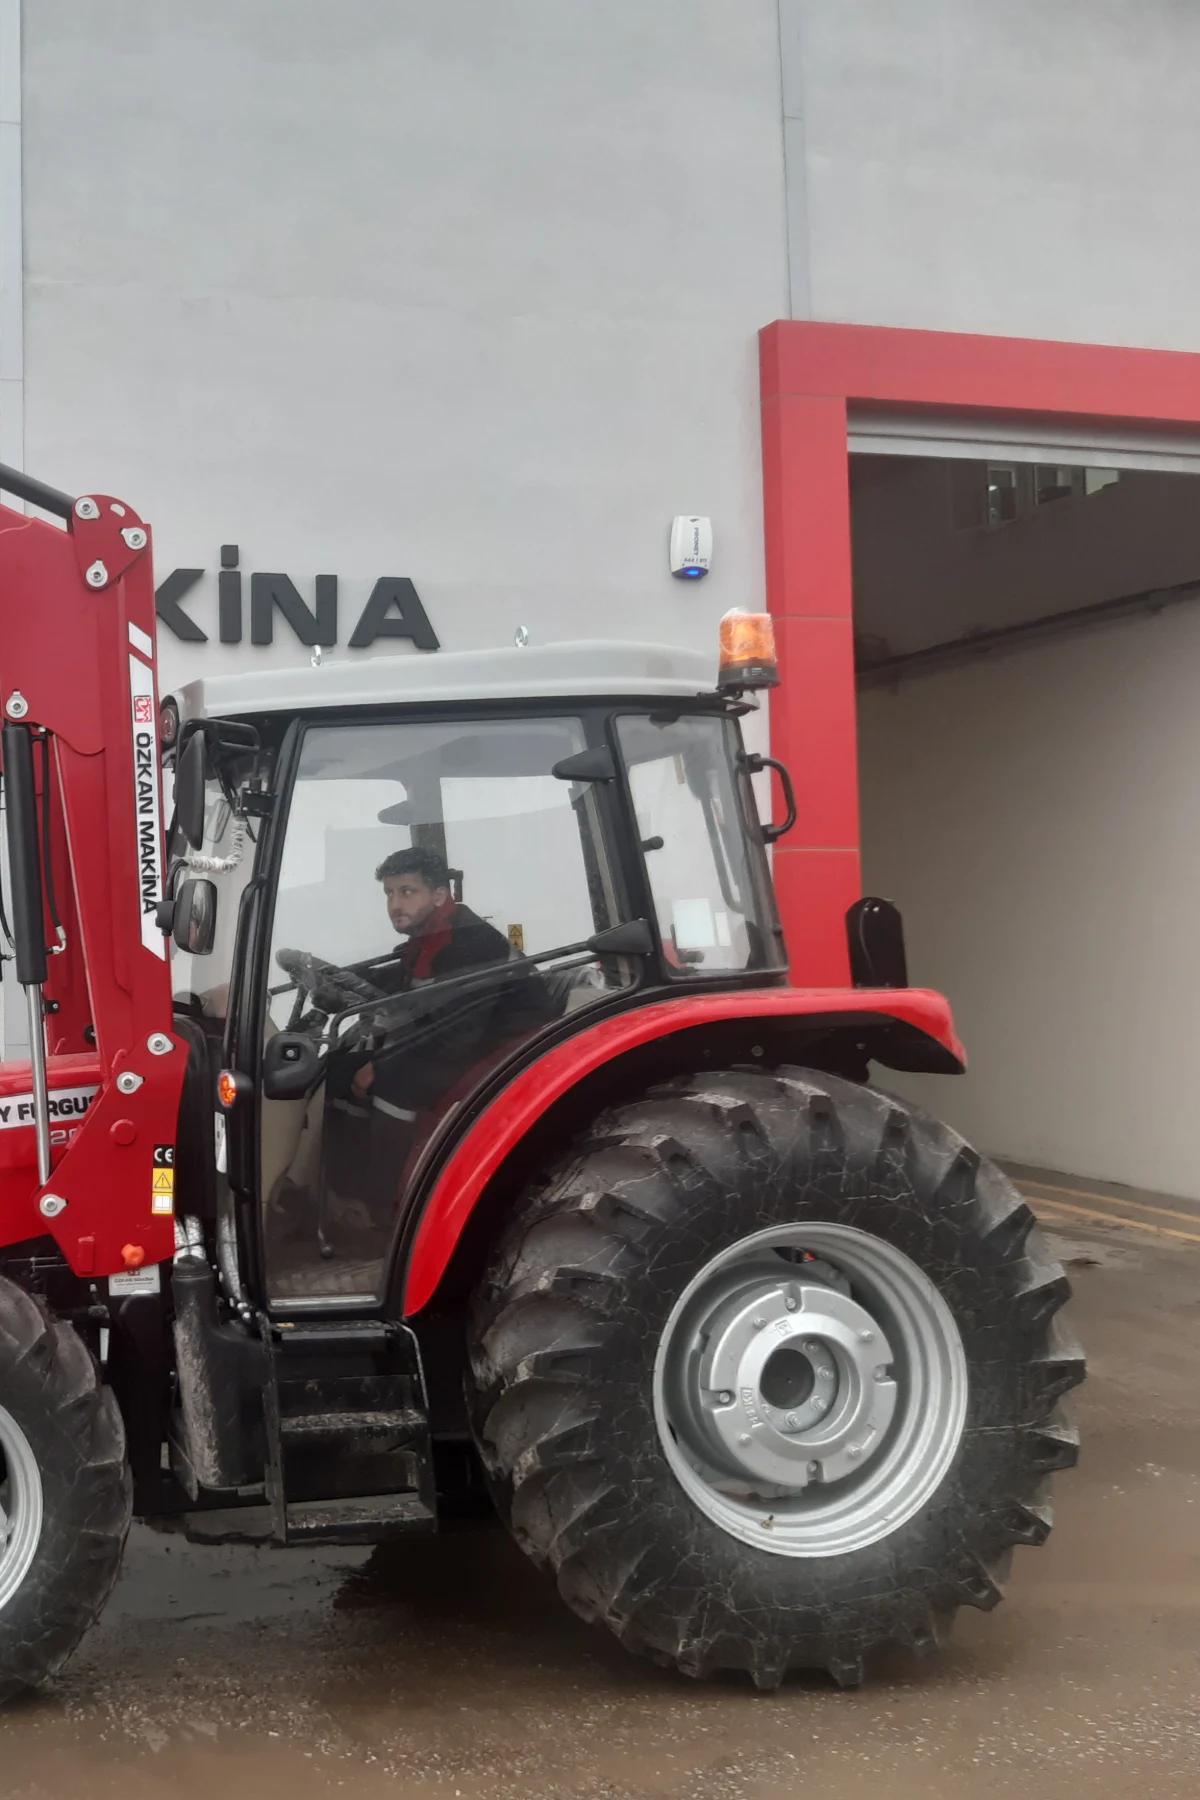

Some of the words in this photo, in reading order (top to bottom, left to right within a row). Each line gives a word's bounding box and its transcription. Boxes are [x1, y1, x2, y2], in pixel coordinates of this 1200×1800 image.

[155, 545, 440, 649] KİNA
[136, 732, 153, 814] ÖZKAN
[139, 821, 159, 915] MAKİNA
[17, 1095, 96, 1121] FRGU
[154, 1147, 174, 1163] CE
